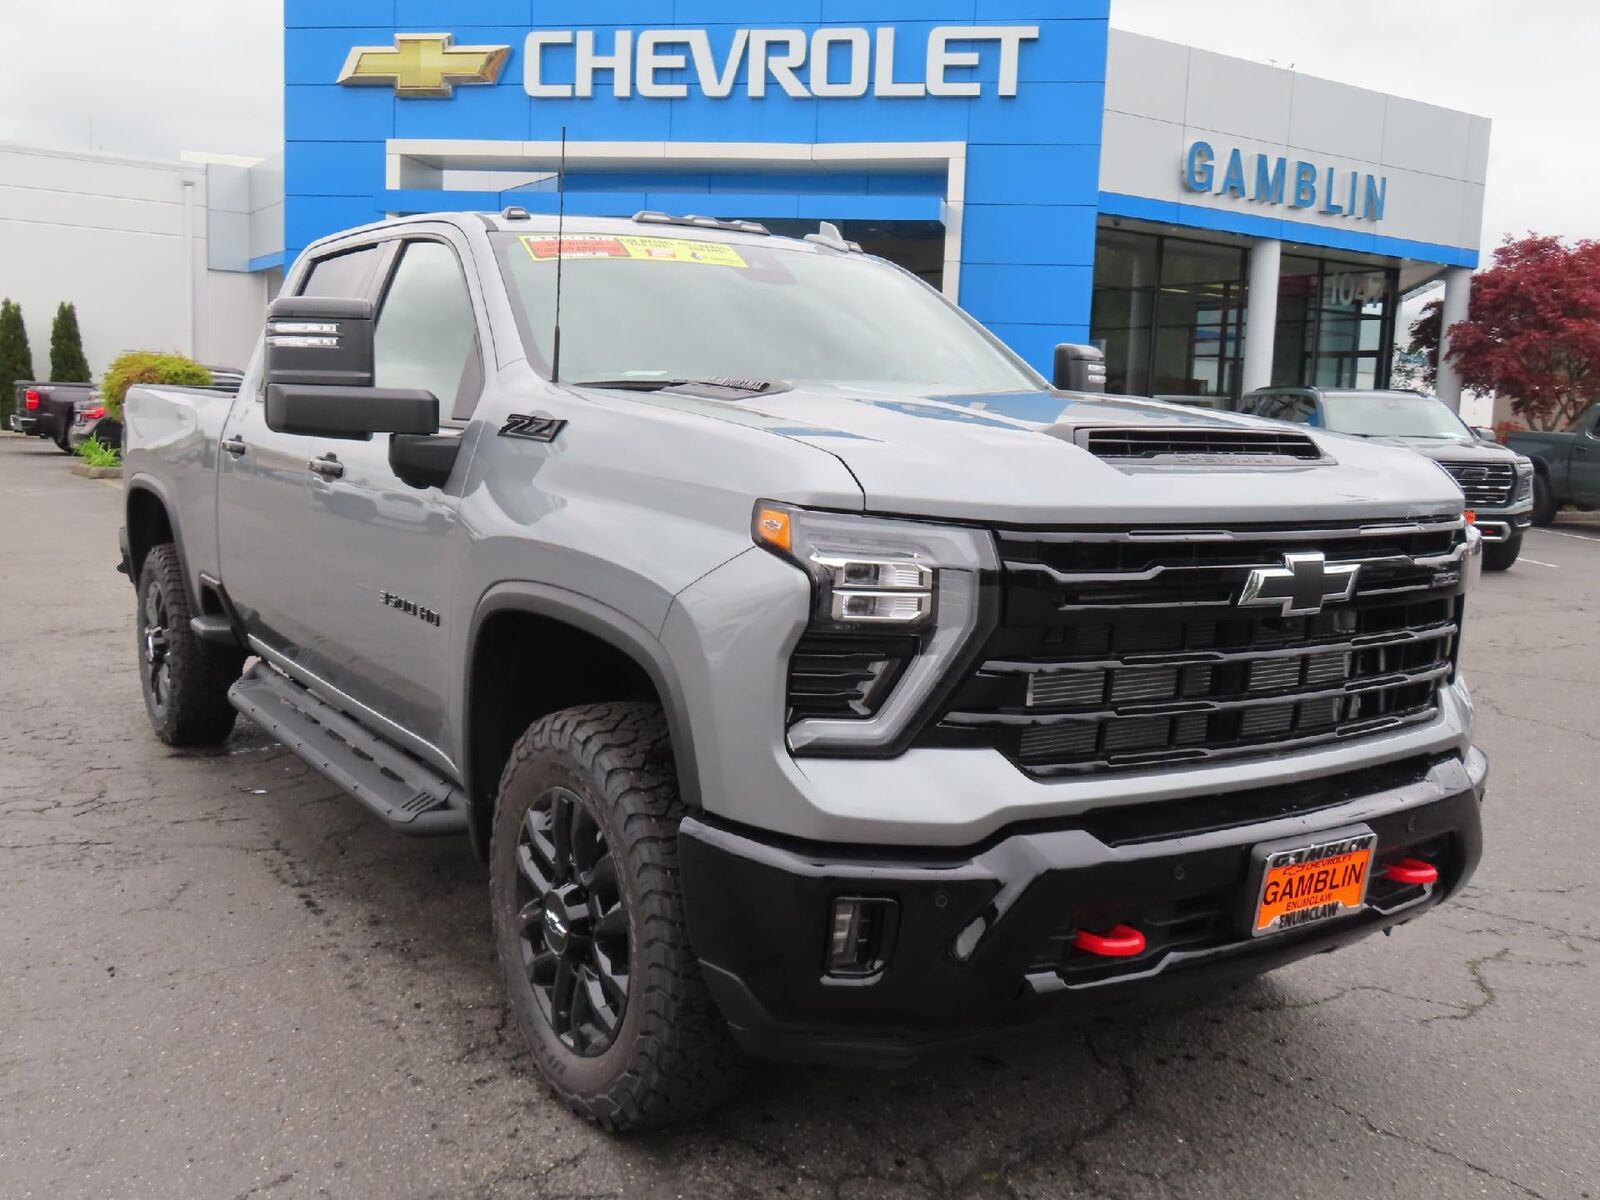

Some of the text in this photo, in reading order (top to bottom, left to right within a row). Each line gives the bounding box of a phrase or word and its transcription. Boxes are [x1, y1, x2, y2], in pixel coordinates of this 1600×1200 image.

[523, 26, 1041, 99] CHEVROLET
[1184, 141, 1387, 221] GAMBLIN
[497, 413, 568, 443] Z71
[1305, 854, 1353, 871] CHEVROLET
[1262, 862, 1364, 906] GAMBLIN
[1278, 901, 1339, 929] ENUMCLAW
[1285, 892, 1333, 911] ENUMCLAW
